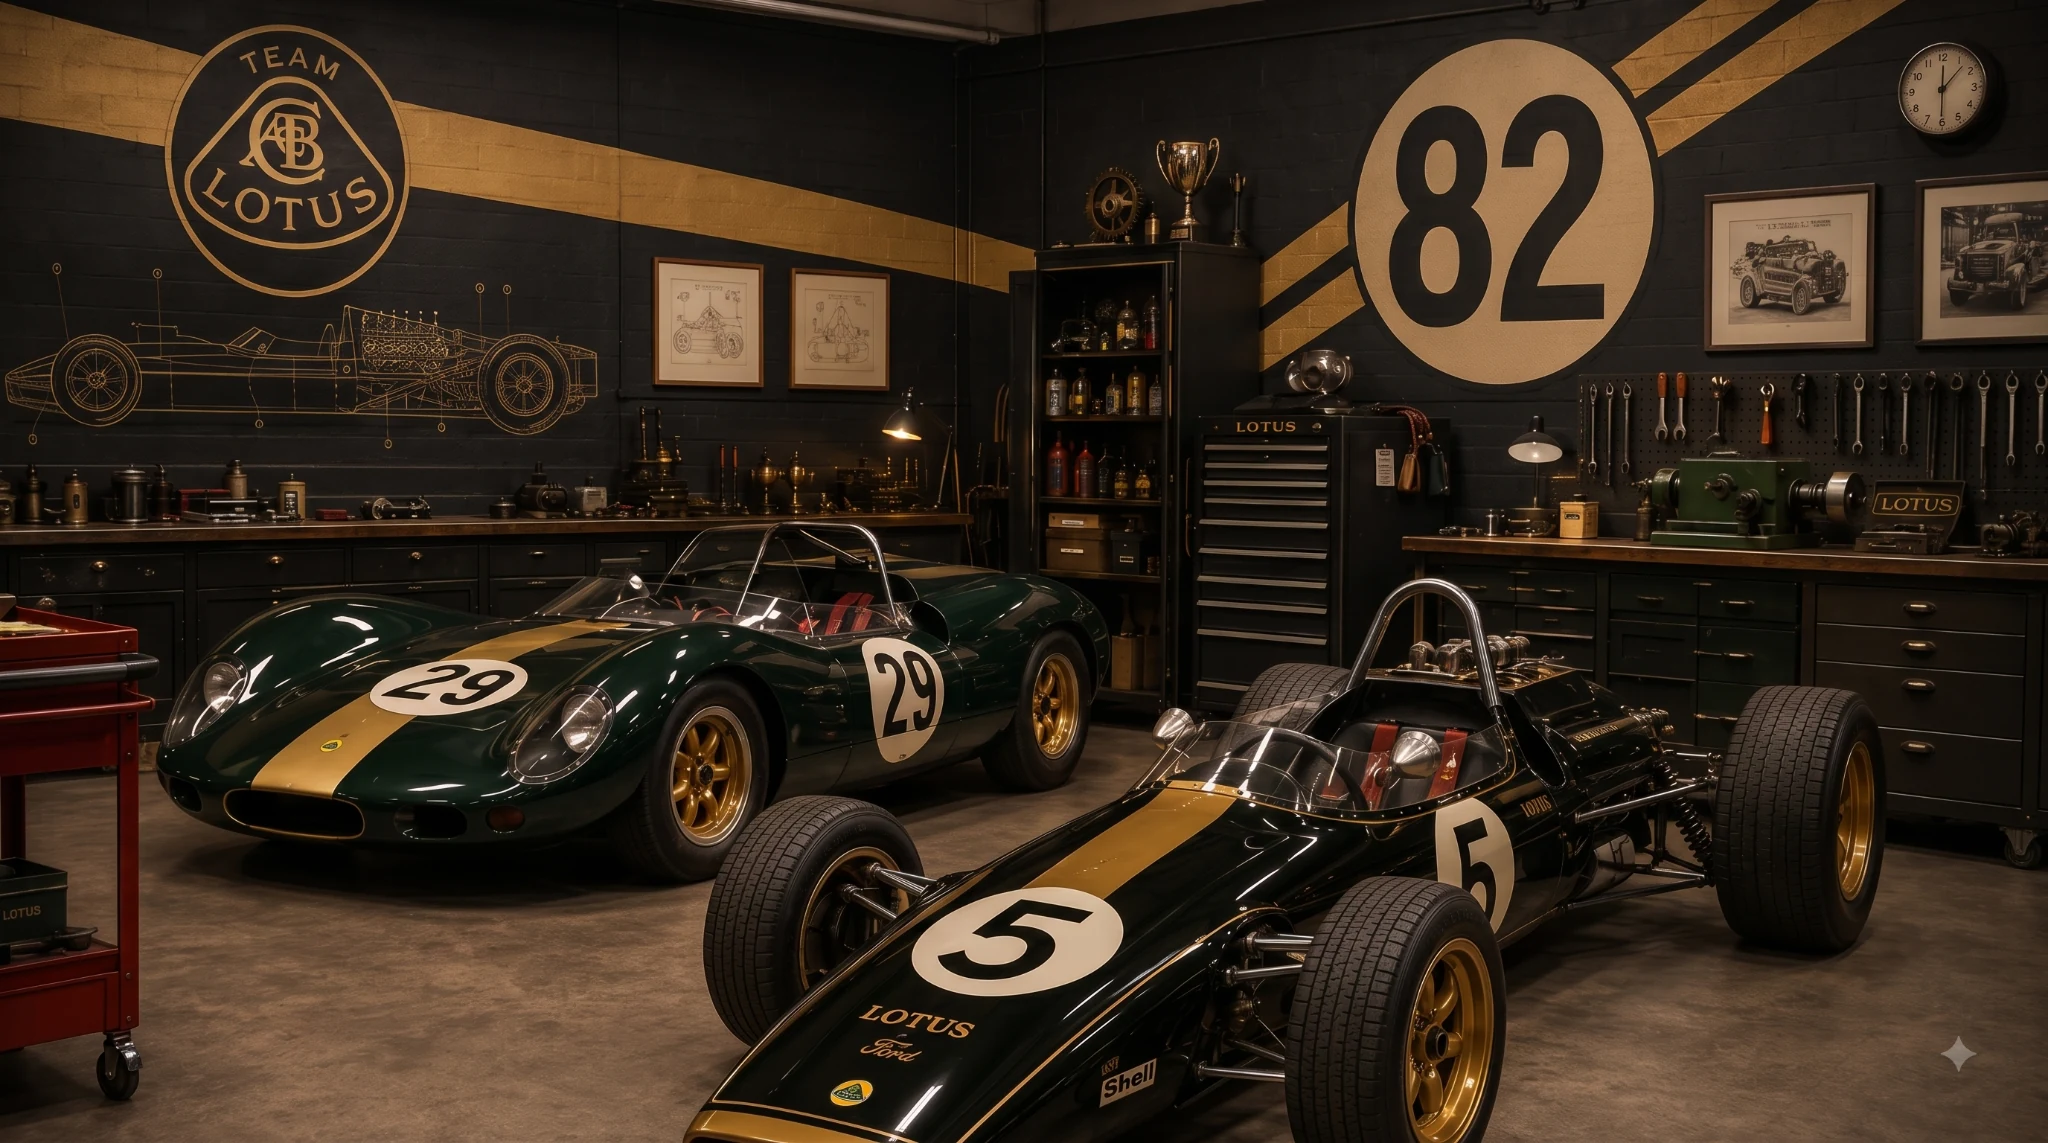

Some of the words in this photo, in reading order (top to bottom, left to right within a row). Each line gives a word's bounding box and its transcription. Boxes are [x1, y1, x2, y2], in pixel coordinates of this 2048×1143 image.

[239, 45, 341, 81] TEAM
[1925, 59, 1932, 68] 11
[1938, 53, 1948, 62] 12
[1913, 72, 1922, 81] 10
[1967, 66, 1974, 75] 2
[1909, 88, 1915, 96] 9
[1971, 82, 1978, 92] 3
[1913, 104, 1919, 112] 8
[1924, 114, 1931, 125] 7
[1939, 118, 1945, 126] 6
[1955, 112, 1961, 120] 5
[202, 167, 377, 231] LOTUS
[1389, 94, 1605, 328] 82
[1236, 421, 1297, 433] LOTUS
[1881, 497, 1953, 512] LOTUS
[381, 664, 515, 706] 29
[874, 650, 937, 738] 29
[1453, 816, 1497, 922] 5
[2, 905, 42, 921] LOTUS
[937, 899, 1094, 980] 5
[858, 1004, 976, 1039] LOTUS
[860, 1038, 923, 1062] Ford
[1104, 1061, 1154, 1099] Shell
